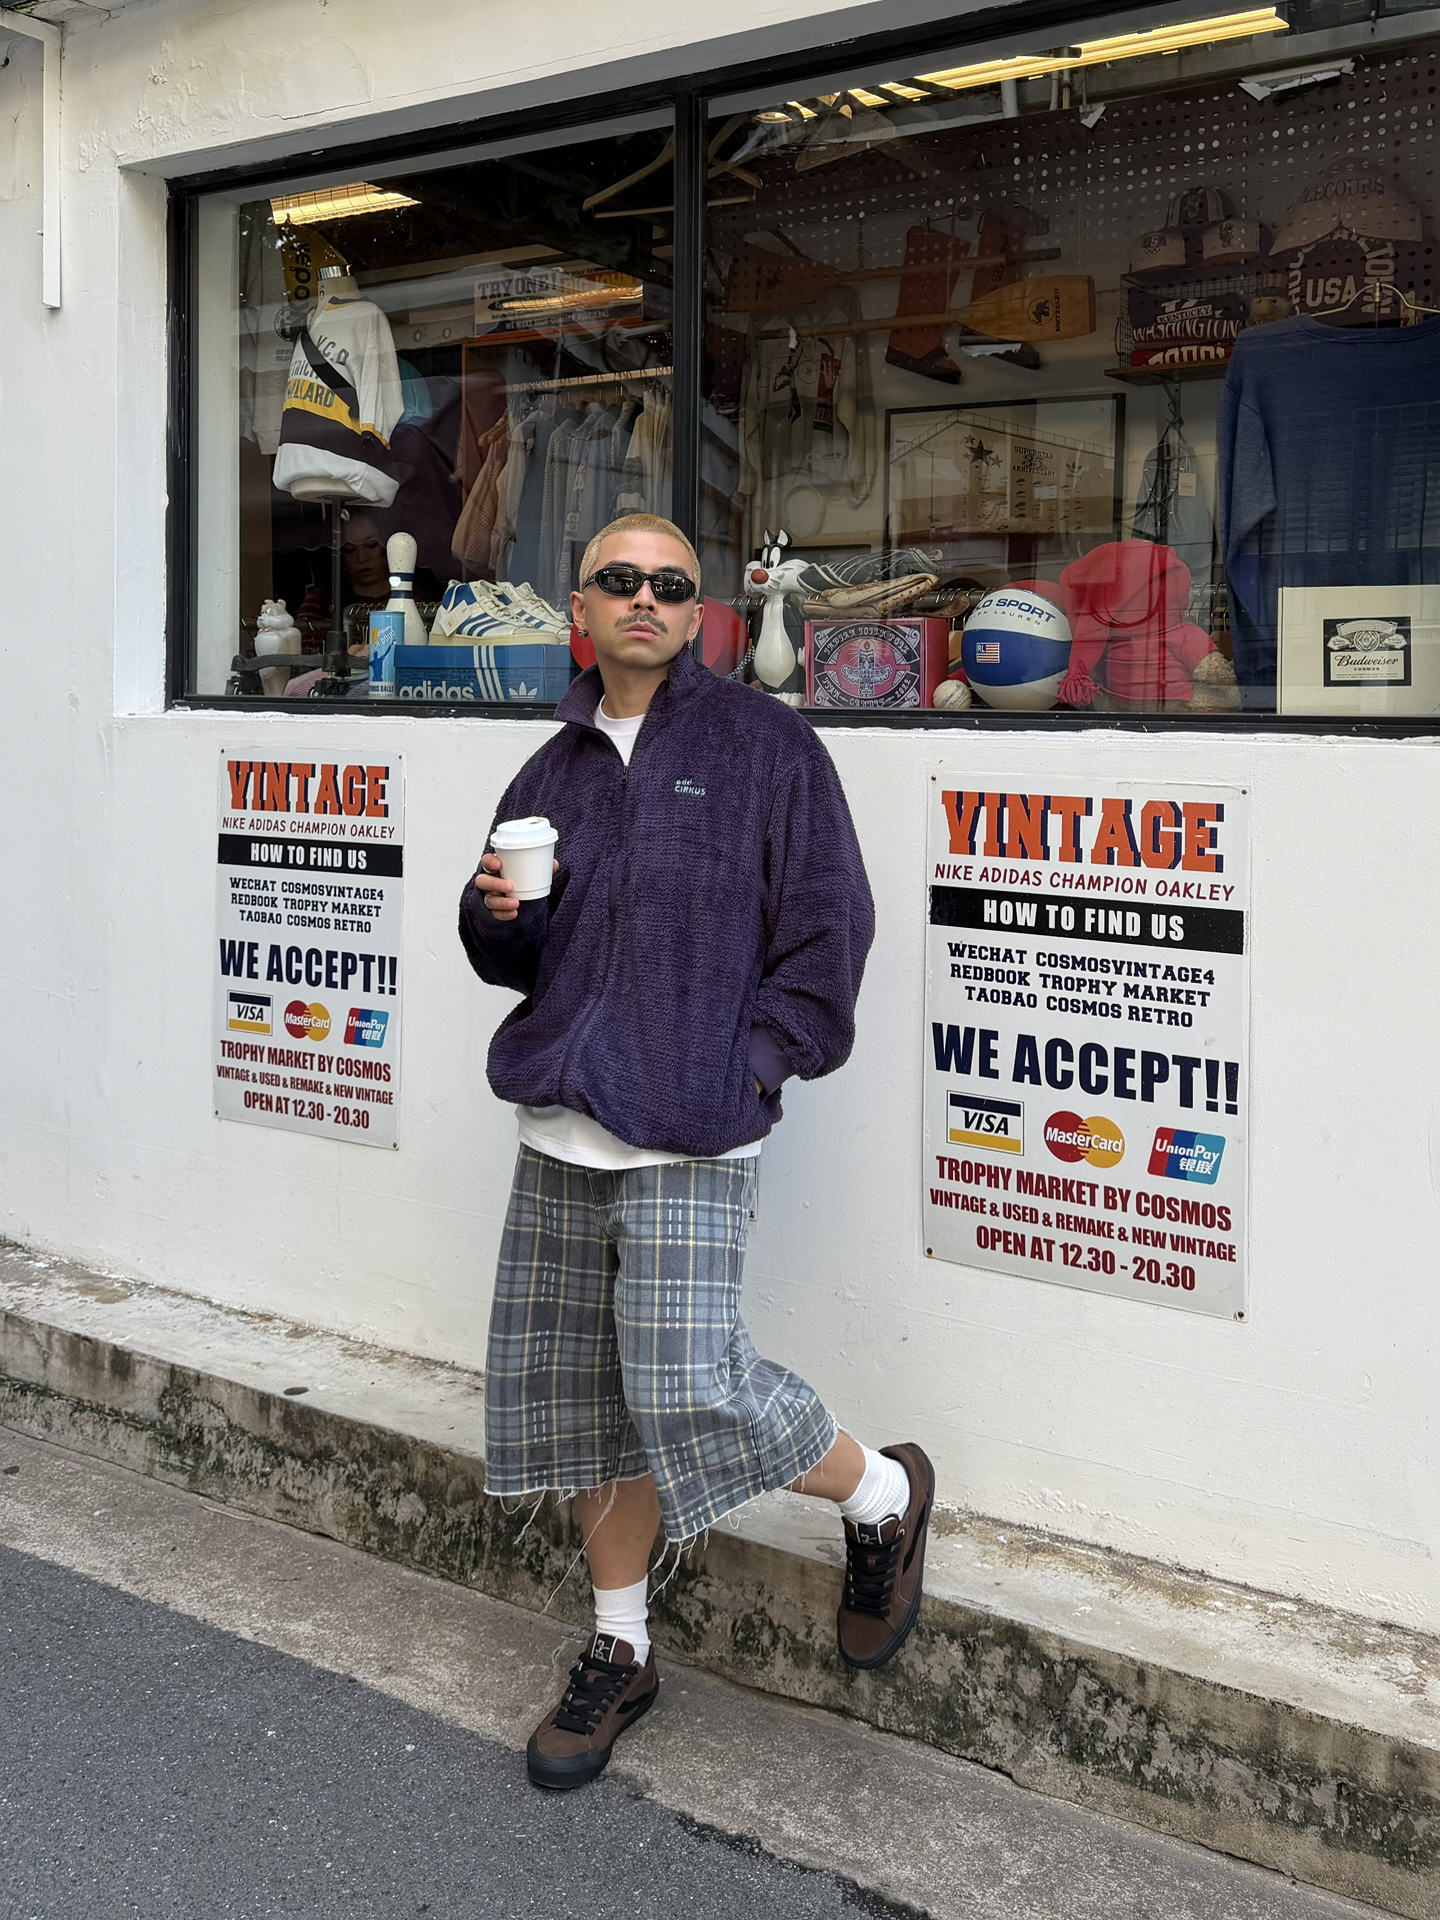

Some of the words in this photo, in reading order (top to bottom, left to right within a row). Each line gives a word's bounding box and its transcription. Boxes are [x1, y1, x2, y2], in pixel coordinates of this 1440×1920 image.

[478, 277, 511, 300] TRY
[515, 272, 557, 295] ONE!
[595, 271, 634, 287] JOHN
[1306, 275, 1357, 307] USA
[1053, 288, 1061, 332] METZELER
[1158, 306, 1210, 323] KENTUCKY
[1014, 446, 1055, 460] SUPERSTAR
[1012, 465, 1056, 478] ANNIVERSARY
[994, 610, 1041, 626] LAUREN
[996, 598, 1055, 623] SPORT
[824, 628, 858, 655] INDIAN
[888, 634, 910, 655] POLE
[1335, 654, 1398, 667] Budweiser
[399, 680, 475, 700] adidas
[895, 678, 911, 697] 2022
[227, 760, 389, 818] VINTAGE
[674, 785, 706, 796] CIRKUS
[222, 817, 245, 829] NIKE
[249, 818, 286, 831] ADIDAS
[290, 820, 346, 836] CHAMPION
[350, 824, 395, 838] OAKLEY
[941, 790, 1224, 873] VINTAGE
[251, 843, 283, 863] HOW
[287, 845, 305, 865] TO
[310, 847, 342, 868] FIND
[347, 850, 367, 869] US
[230, 877, 276, 892] WECHAT
[281, 881, 384, 901] COSMOSVINTAGE4
[935, 864, 973, 881] NIKE
[979, 866, 1042, 886] ADIDAS
[1050, 872, 1147, 895] CHAMPION
[1155, 880, 1235, 901] OAKLEY
[231, 893, 278, 908] REDBOOK
[283, 897, 328, 913] TROPHY
[331, 902, 381, 917] MARKET
[239, 910, 281, 924] TAOBAO
[287, 914, 330, 929] COSMOS
[334, 918, 371, 933] RETRO
[984, 899, 1037, 927] HOW
[1046, 904, 1075, 931] TO
[1085, 906, 1141, 936] FIND
[1151, 913, 1184, 941] US
[220, 939, 259, 979] WE
[266, 944, 397, 996] ACCEPT!!
[947, 942, 1027, 965] WECHAT
[1036, 951, 1215, 986] COSMOSVINTAGE4
[951, 963, 1030, 987] REDBOOK
[1039, 973, 1117, 998] TROPHY
[1123, 983, 1210, 1007] MARKET
[236, 1004, 264, 1021] VISA
[965, 986, 1037, 1008] TAOBAO
[1046, 996, 1121, 1019] COSMOS
[1128, 1006, 1193, 1028] RETRO
[285, 1013, 331, 1029] MasterCard
[348, 1016, 386, 1034] UnionPay
[220, 1040, 265, 1063] TROPHY
[268, 1047, 315, 1070] MARKET
[318, 1054, 334, 1073] BY
[337, 1057, 391, 1082] COSMOS
[932, 1022, 999, 1079] WE
[1012, 1034, 1239, 1115] ACCEPT!!
[217, 1065, 250, 1082] VINTAGE
[252, 1073, 257, 1083] &
[259, 1074, 280, 1088] USED
[283, 1077, 288, 1088] &
[290, 1078, 324, 1094] REMAKE
[325, 1084, 332, 1095] &
[334, 1084, 353, 1099] NEW
[356, 1087, 393, 1105] VINTAGE
[244, 1091, 272, 1112] OPEN
[275, 1097, 290, 1114] AT
[292, 1099, 324, 1121] 12.30
[334, 1106, 369, 1129] 20.30
[961, 1110, 1009, 1135] VISA
[1046, 1127, 1123, 1153] MasterCard
[1156, 1138, 1219, 1166] UnionPay
[1179, 1158, 1213, 1175] 银联
[936, 1155, 1012, 1191] TROPHY
[1016, 1170, 1098, 1207] MARKET
[1103, 1188, 1131, 1213] BY
[1136, 1191, 1231, 1231] COSMOS
[930, 1188, 986, 1214] VINTAGE
[990, 1201, 999, 1216] &
[1002, 1202, 1039, 1224] USED
[1042, 1212, 1052, 1227] &
[1056, 1213, 1114, 1239] REMAKE
[1118, 1226, 1129, 1242] &
[1132, 1227, 1166, 1250] NEW
[1169, 1233, 1236, 1262] VINTAGE
[976, 1225, 1026, 1257] OPEN
[1030, 1236, 1055, 1262] AT
[1059, 1242, 1115, 1274] 12.30
[1133, 1256, 1195, 1290] 20.30
